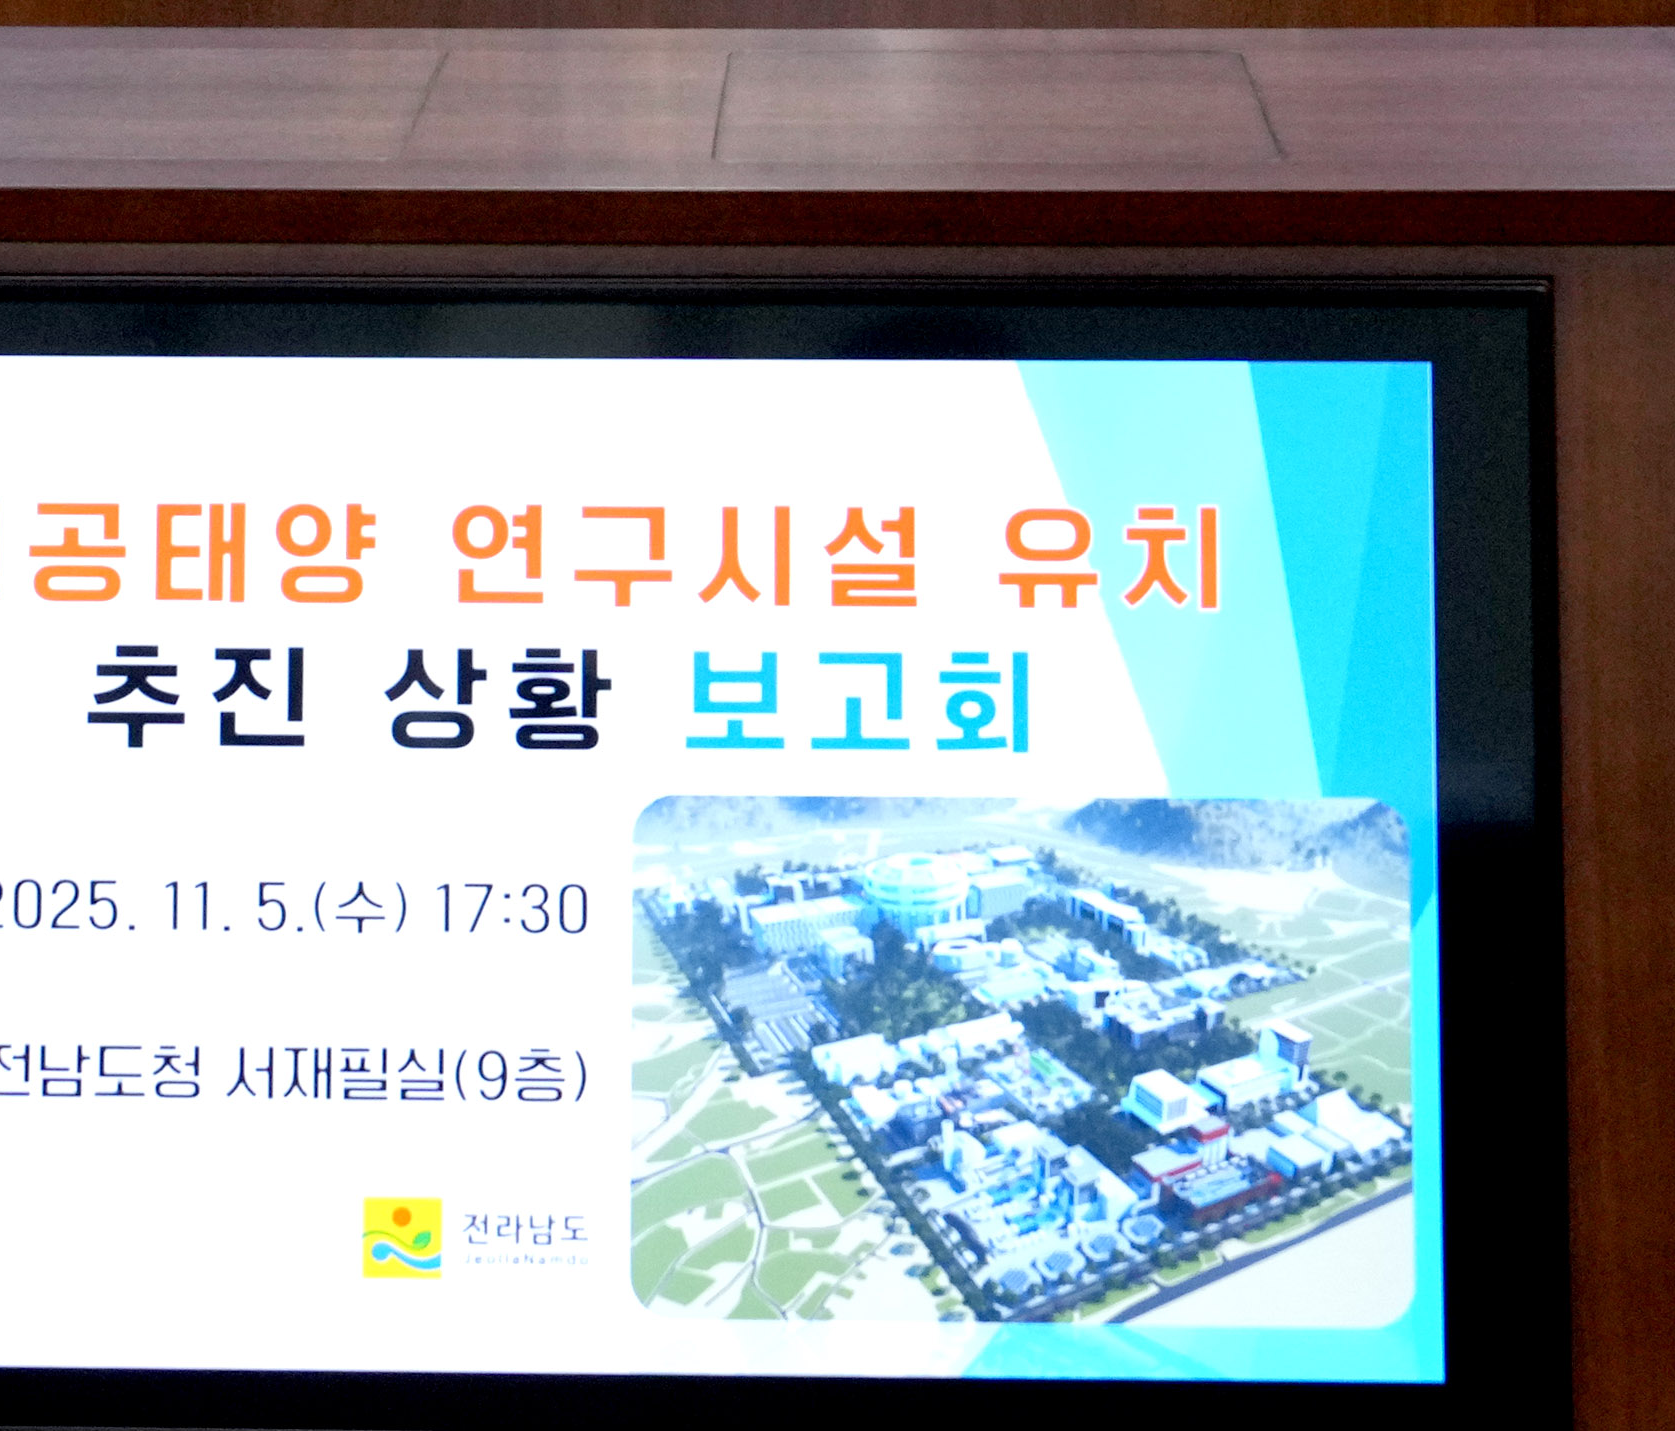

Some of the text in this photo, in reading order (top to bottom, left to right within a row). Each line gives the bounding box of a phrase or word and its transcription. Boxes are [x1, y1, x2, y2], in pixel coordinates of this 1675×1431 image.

[453, 505, 917, 607] 연구시설
[998, 507, 1217, 609] 유치
[87, 645, 1029, 753] 추진 상황 보고회
[437, 883, 588, 934] 17:30
[226, 1046, 587, 1102] 서재필실(9층)
[462, 1213, 589, 1246] 전라남도
